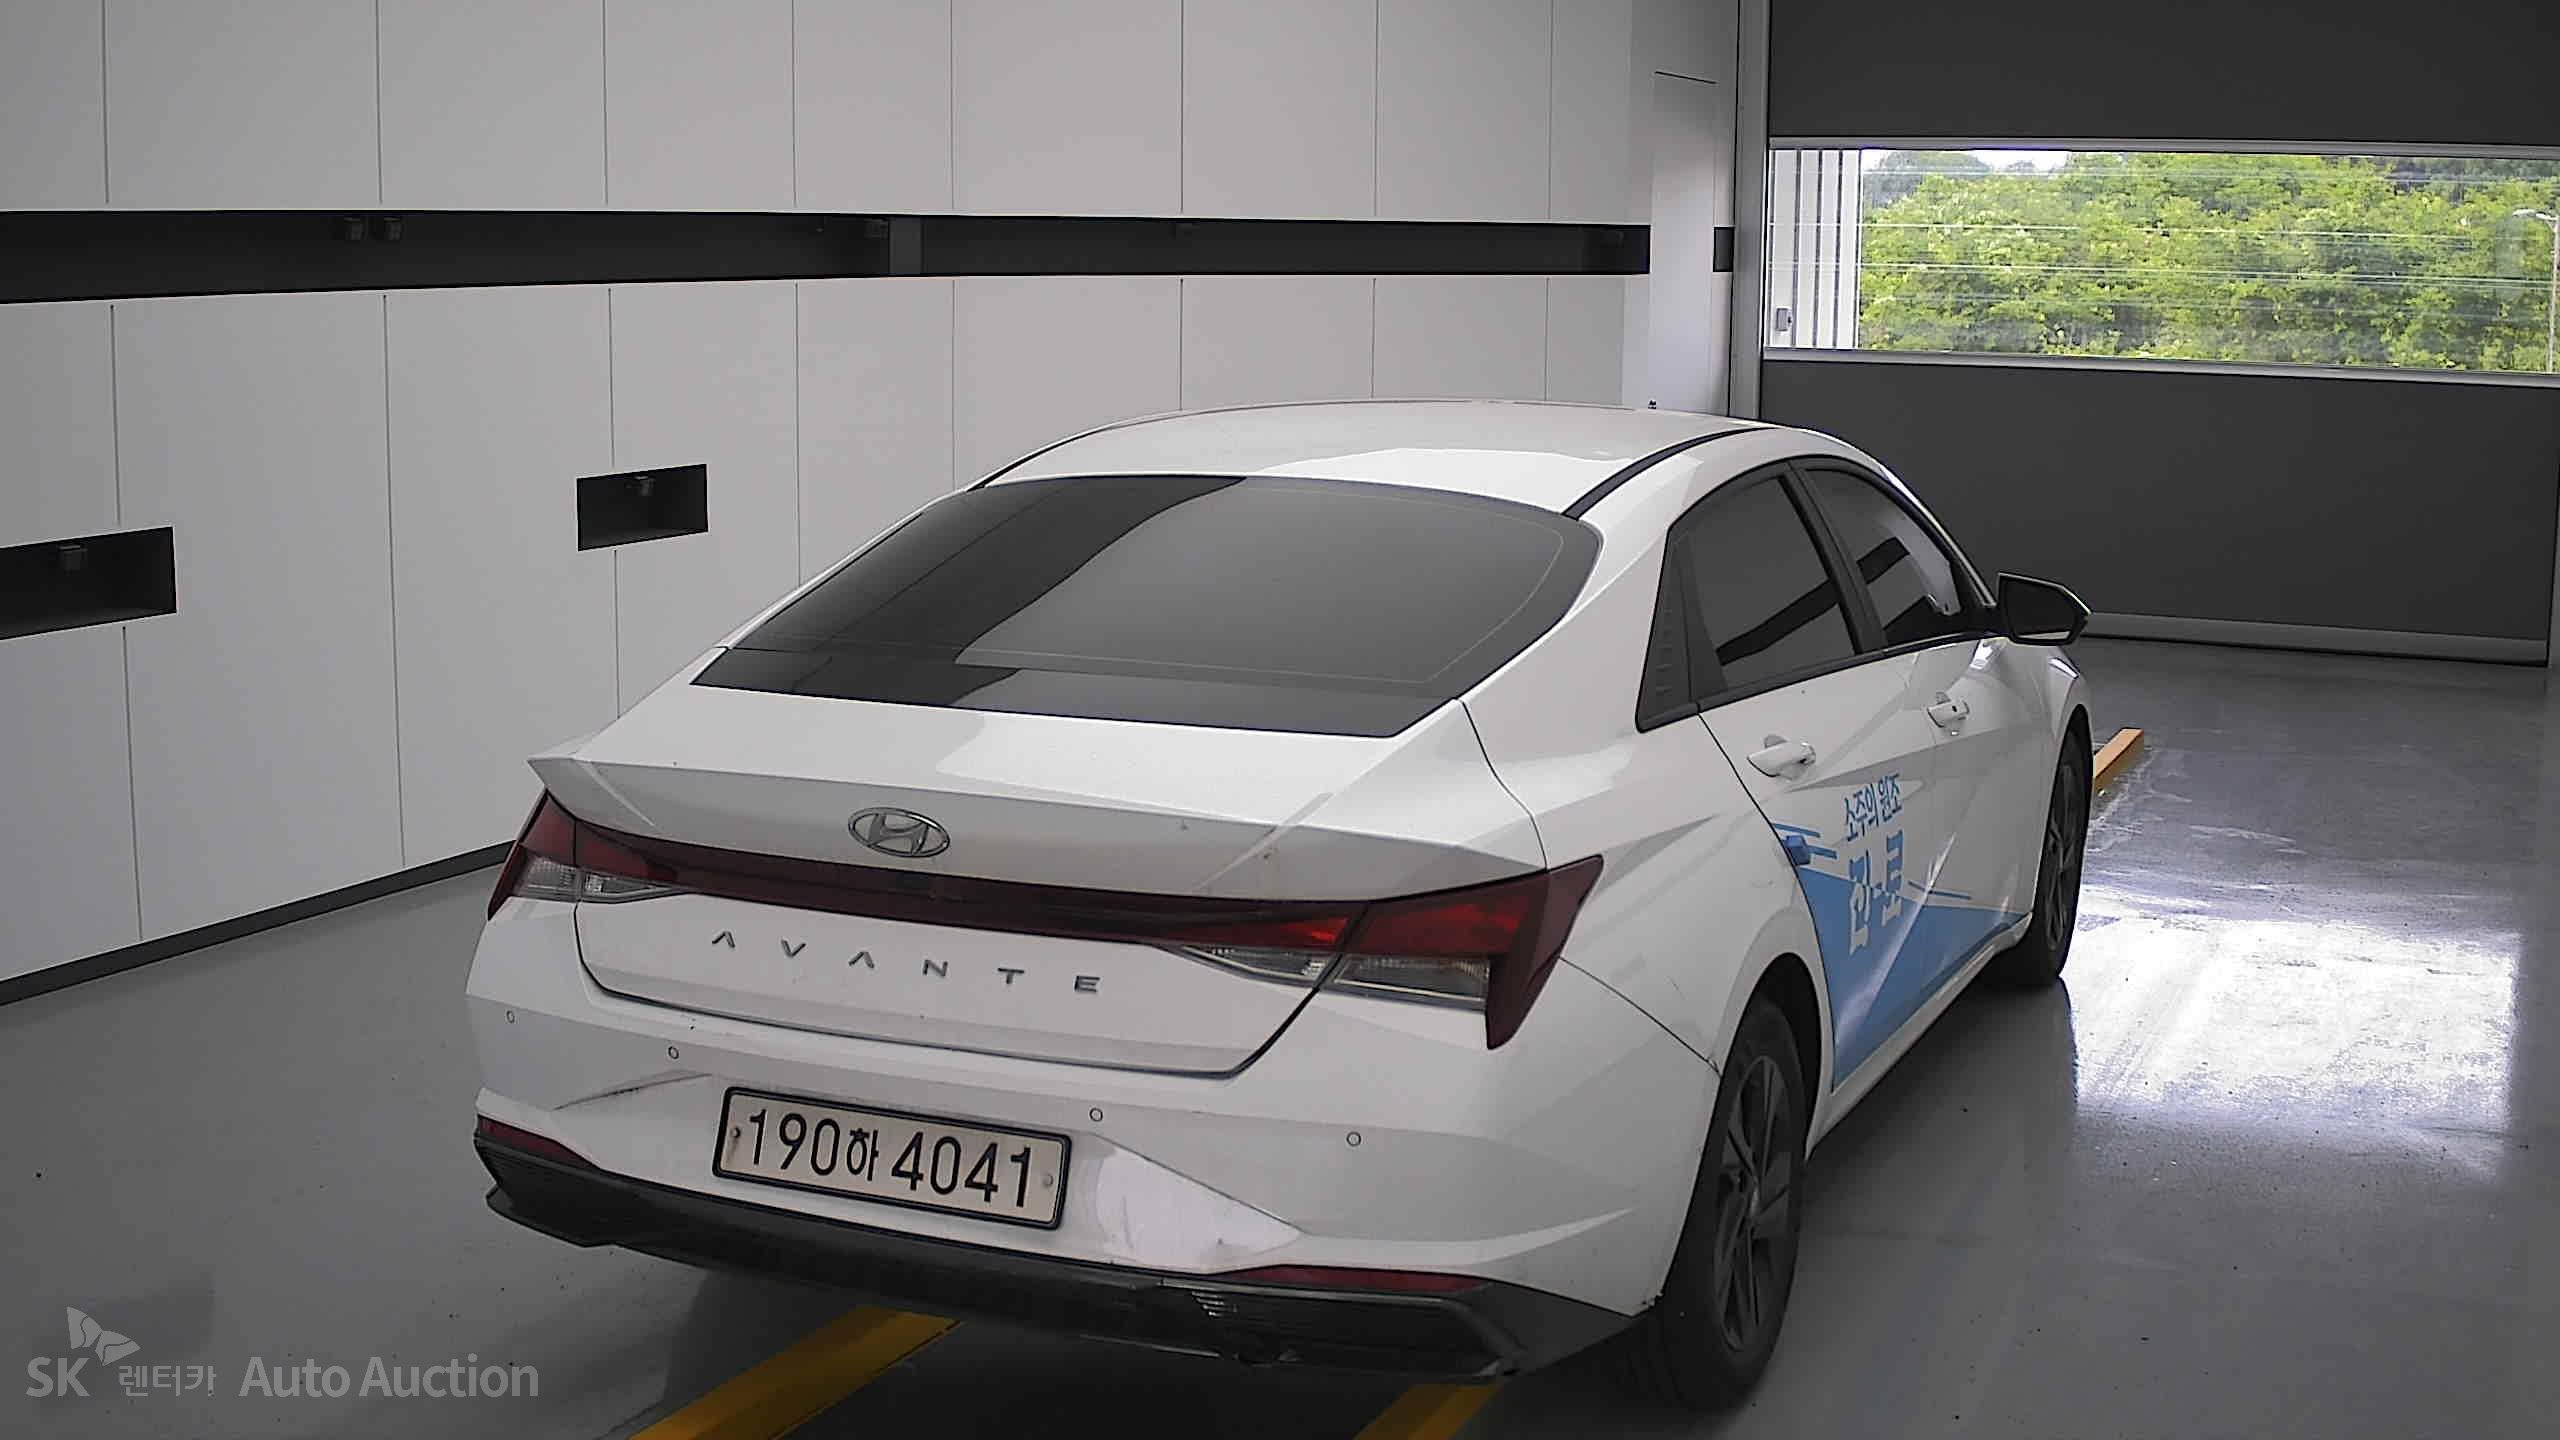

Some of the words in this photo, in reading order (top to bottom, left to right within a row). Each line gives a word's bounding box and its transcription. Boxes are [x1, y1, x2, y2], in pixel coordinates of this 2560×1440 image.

[1844, 783, 1879, 842] 소주의
[1877, 774, 1902, 822] 원조
[711, 929, 1102, 994] AVANTE
[748, 1107, 880, 1182] 190하
[891, 1131, 1033, 1209] 4041
